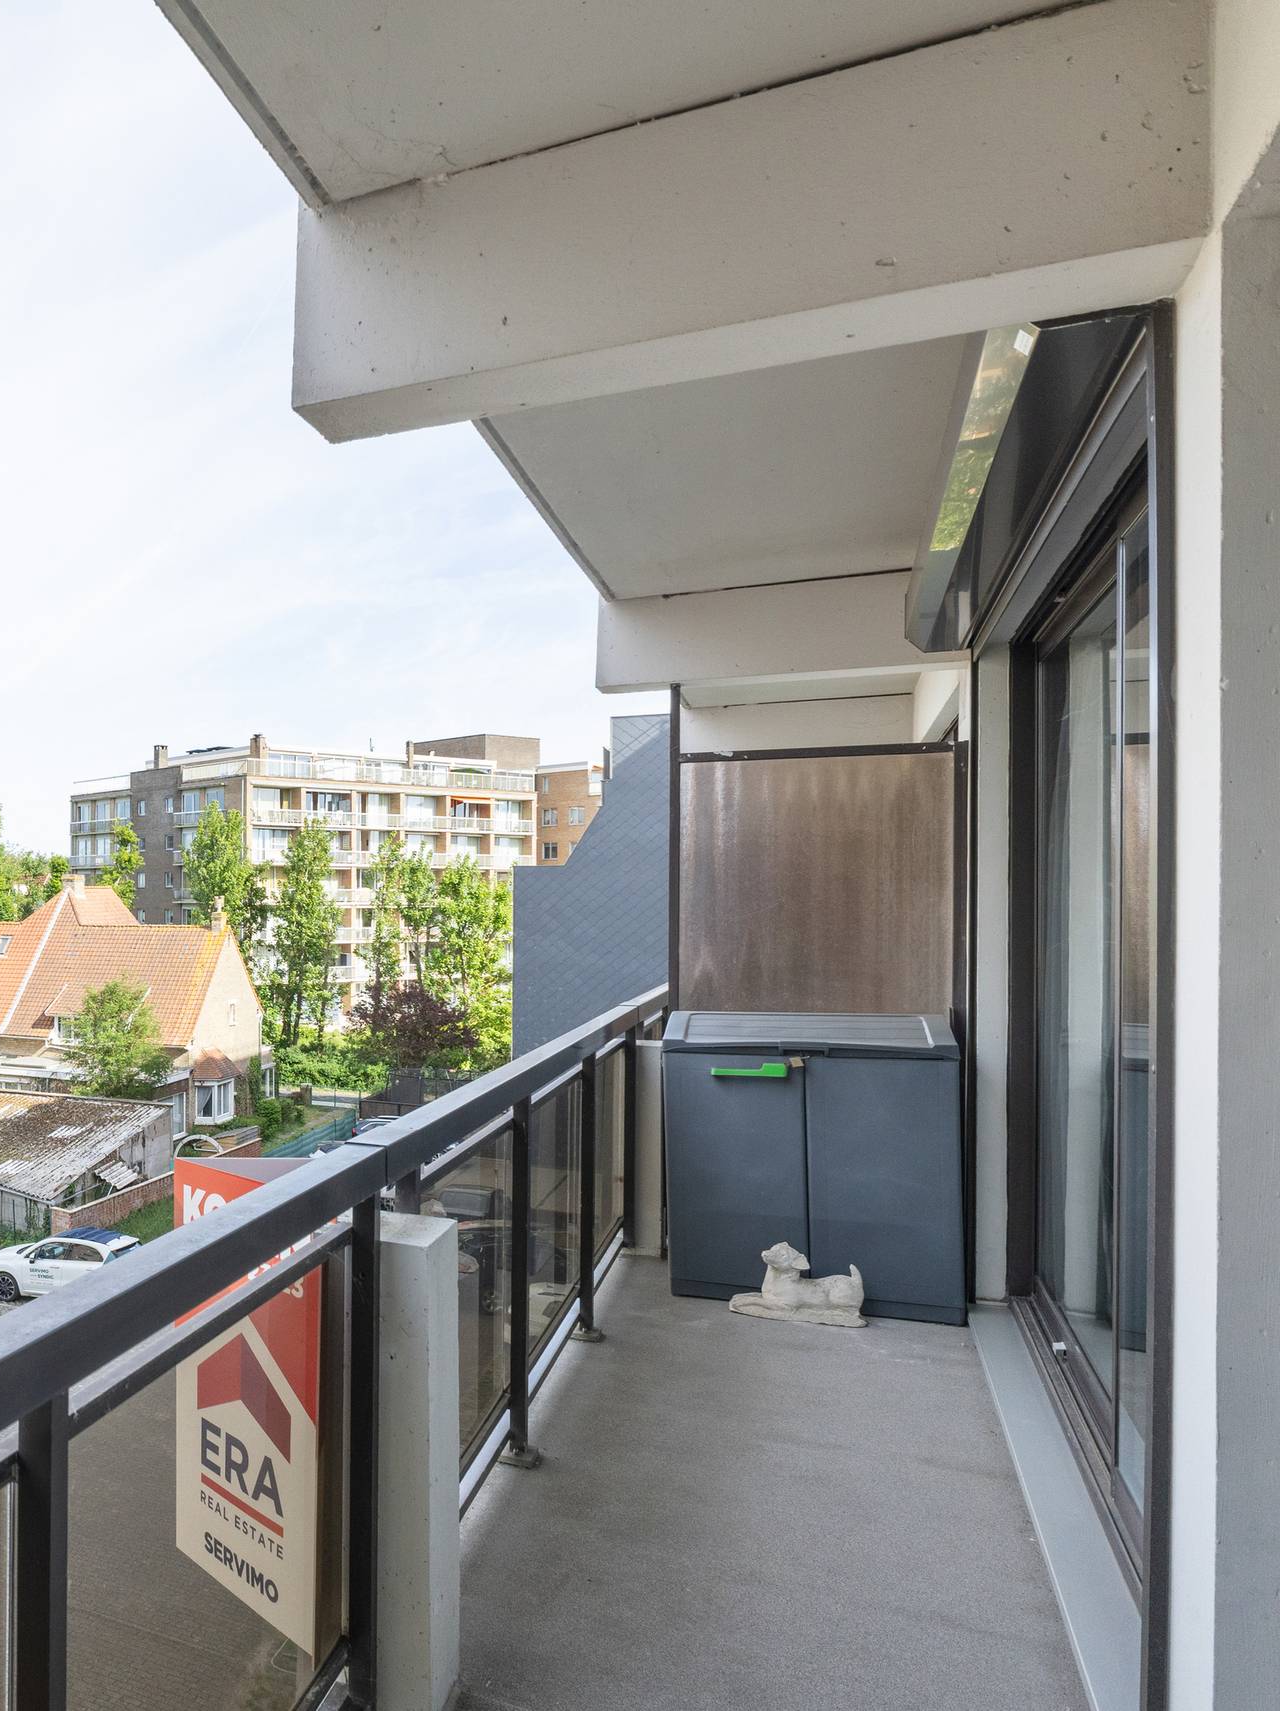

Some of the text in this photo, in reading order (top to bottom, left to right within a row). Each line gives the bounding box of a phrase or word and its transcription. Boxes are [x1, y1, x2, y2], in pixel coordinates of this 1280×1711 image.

[201, 1417, 283, 1518] ERA
[200, 1490, 283, 1560] REAL ESTATE
[204, 1531, 278, 1603] SERVIMO
